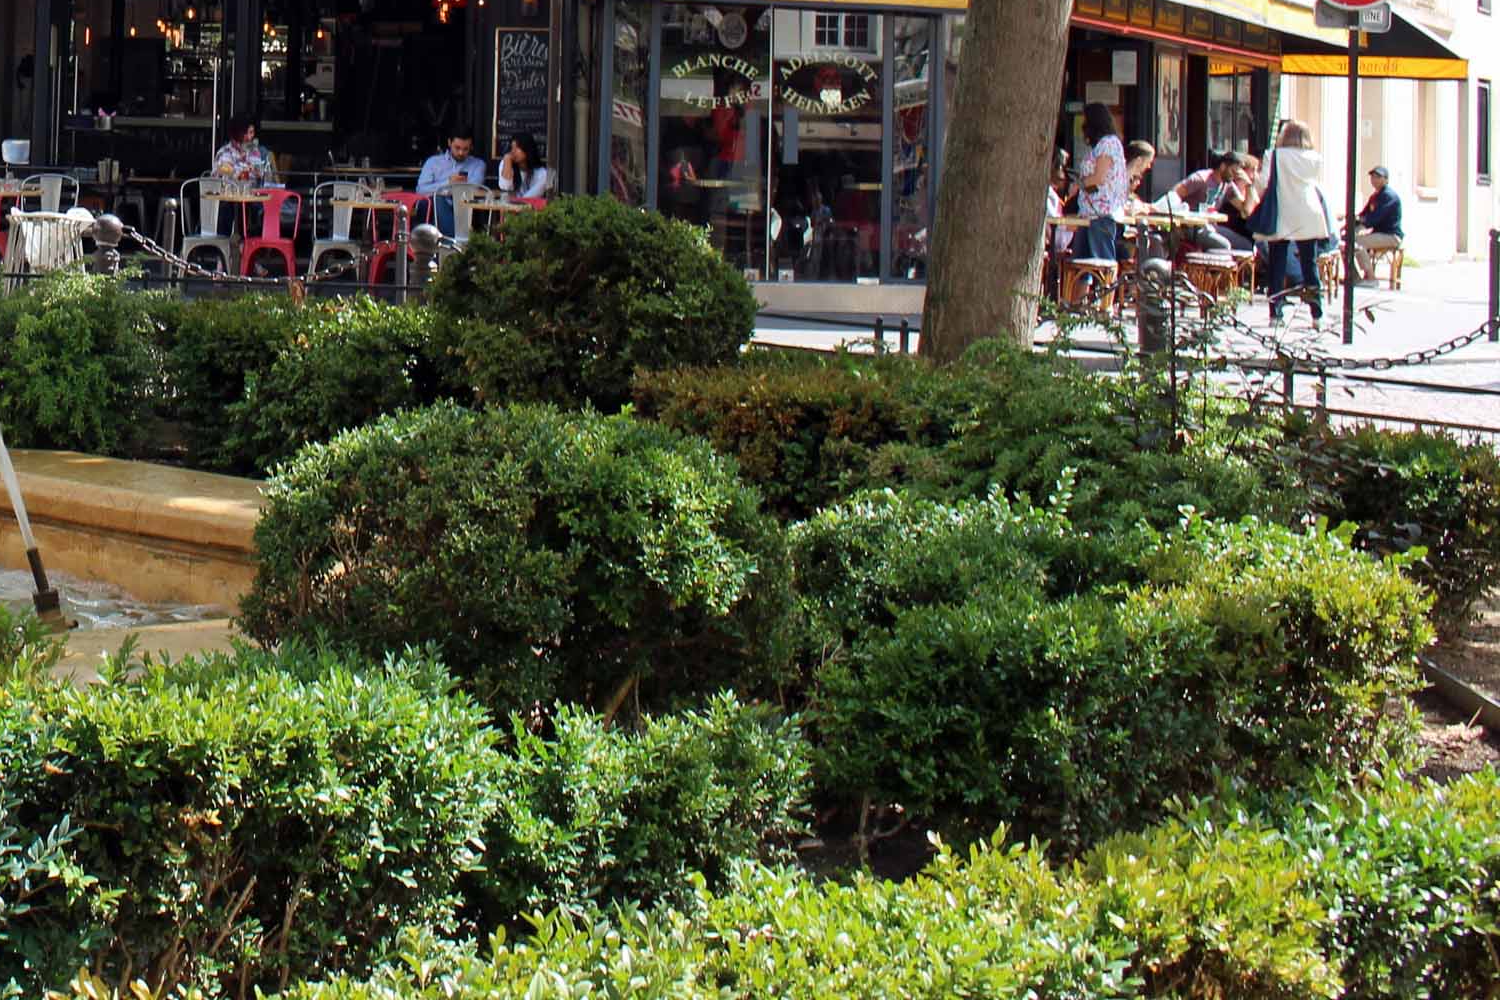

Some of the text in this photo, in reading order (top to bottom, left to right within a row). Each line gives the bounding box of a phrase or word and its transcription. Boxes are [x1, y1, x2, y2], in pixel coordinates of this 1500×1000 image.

[671, 53, 759, 79] BLANCHE
[683, 91, 750, 110] LEFFE
[782, 86, 873, 115] HEINEKEN
